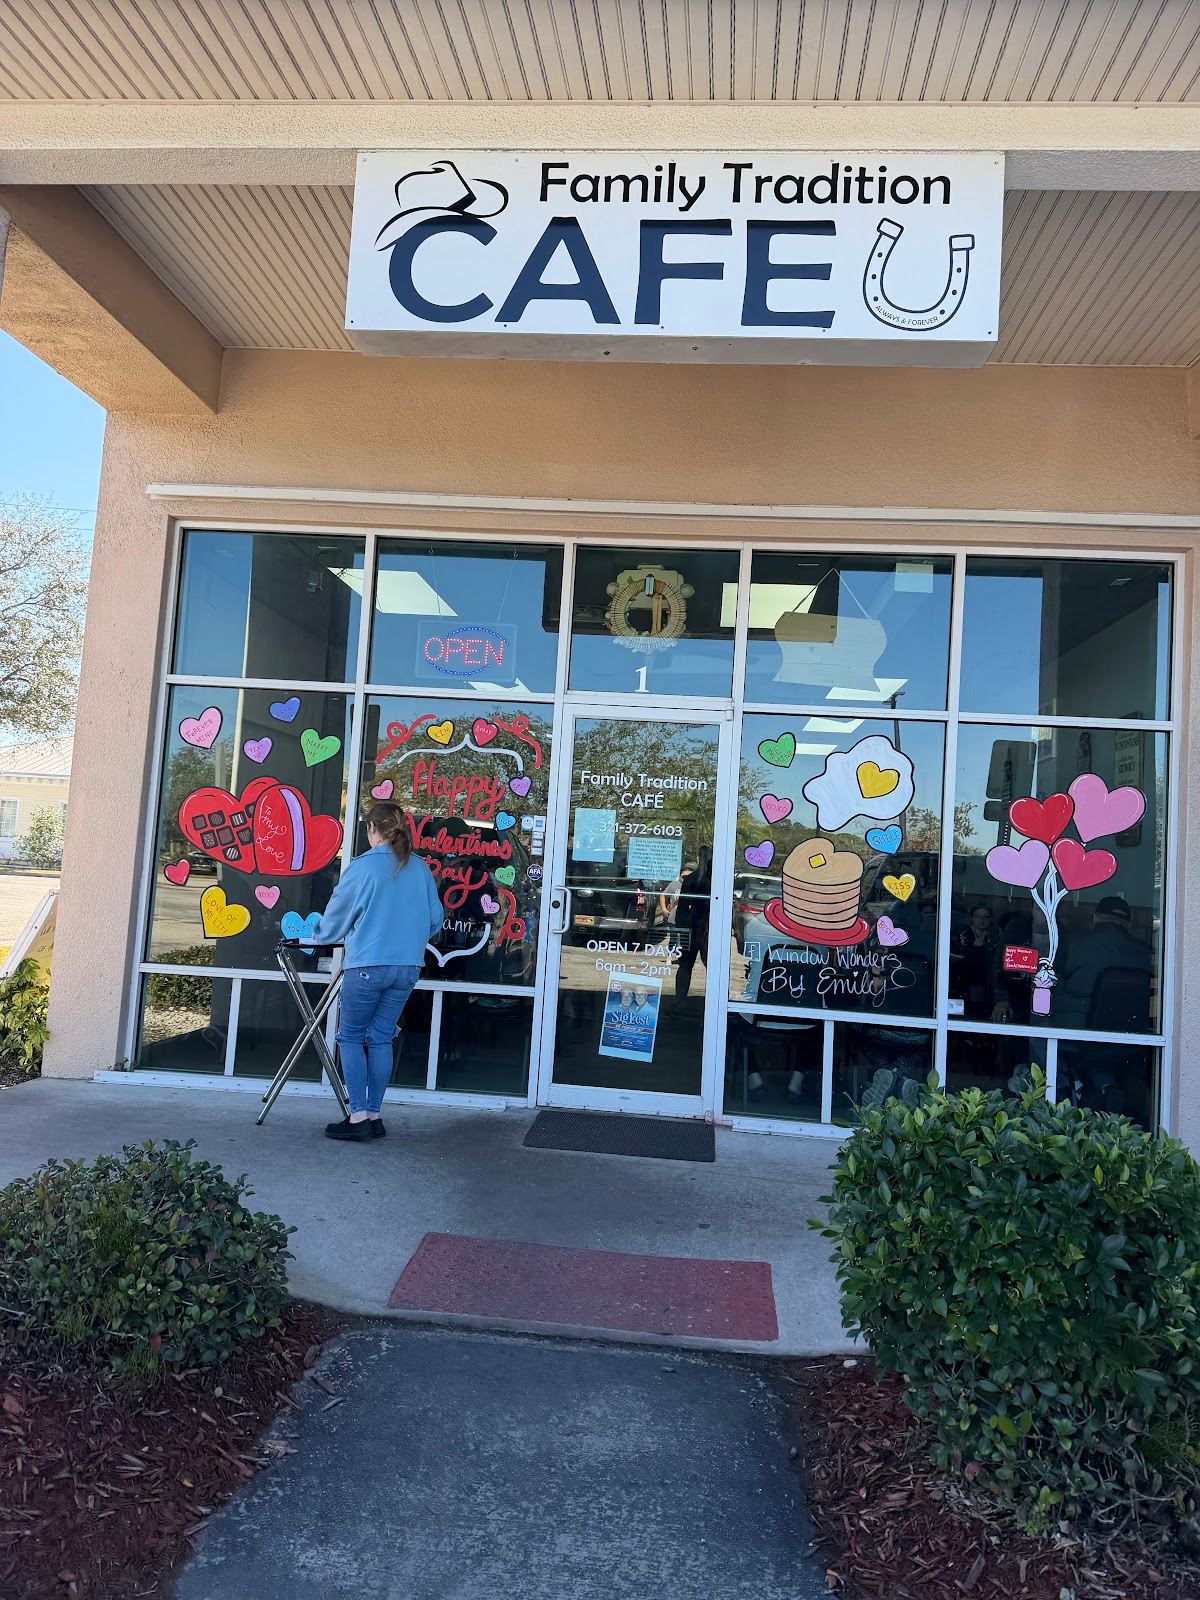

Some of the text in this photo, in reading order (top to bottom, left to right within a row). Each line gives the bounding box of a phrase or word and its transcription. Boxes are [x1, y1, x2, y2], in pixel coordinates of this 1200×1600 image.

[540, 162, 951, 211] Family Tradition
[389, 215, 836, 328] CAFE
[875, 305, 900, 322] ALWAYS
[908, 316, 939, 325] FOREVER
[424, 636, 504, 665] OPEN
[635, 666, 649, 693] 1
[196, 730, 214, 744] MINE
[306, 738, 329, 752] MARRY
[306, 750, 317, 758] ME
[767, 745, 781, 759] BE
[774, 751, 793, 764] MINE
[411, 760, 506, 820] Happy
[581, 770, 708, 790] Family Tradition
[621, 792, 664, 809] CAFÉ
[765, 802, 788, 813] XOXO
[403, 811, 512, 860] Valentines
[600, 821, 683, 837] 321-372-6103
[872, 831, 900, 847] SMILE
[748, 850, 767, 860] CALL
[887, 881, 911, 890] KISS
[205, 895, 238, 924] LOVE OF
[878, 920, 899, 944] BESTIE
[586, 939, 683, 959] OPEN 7 DAYS
[768, 944, 829, 965] Window
[835, 945, 902, 969] Wonders
[595, 959, 626, 973] 6am
[640, 961, 672, 977] 2pm
[761, 967, 888, 1008] By Emily
